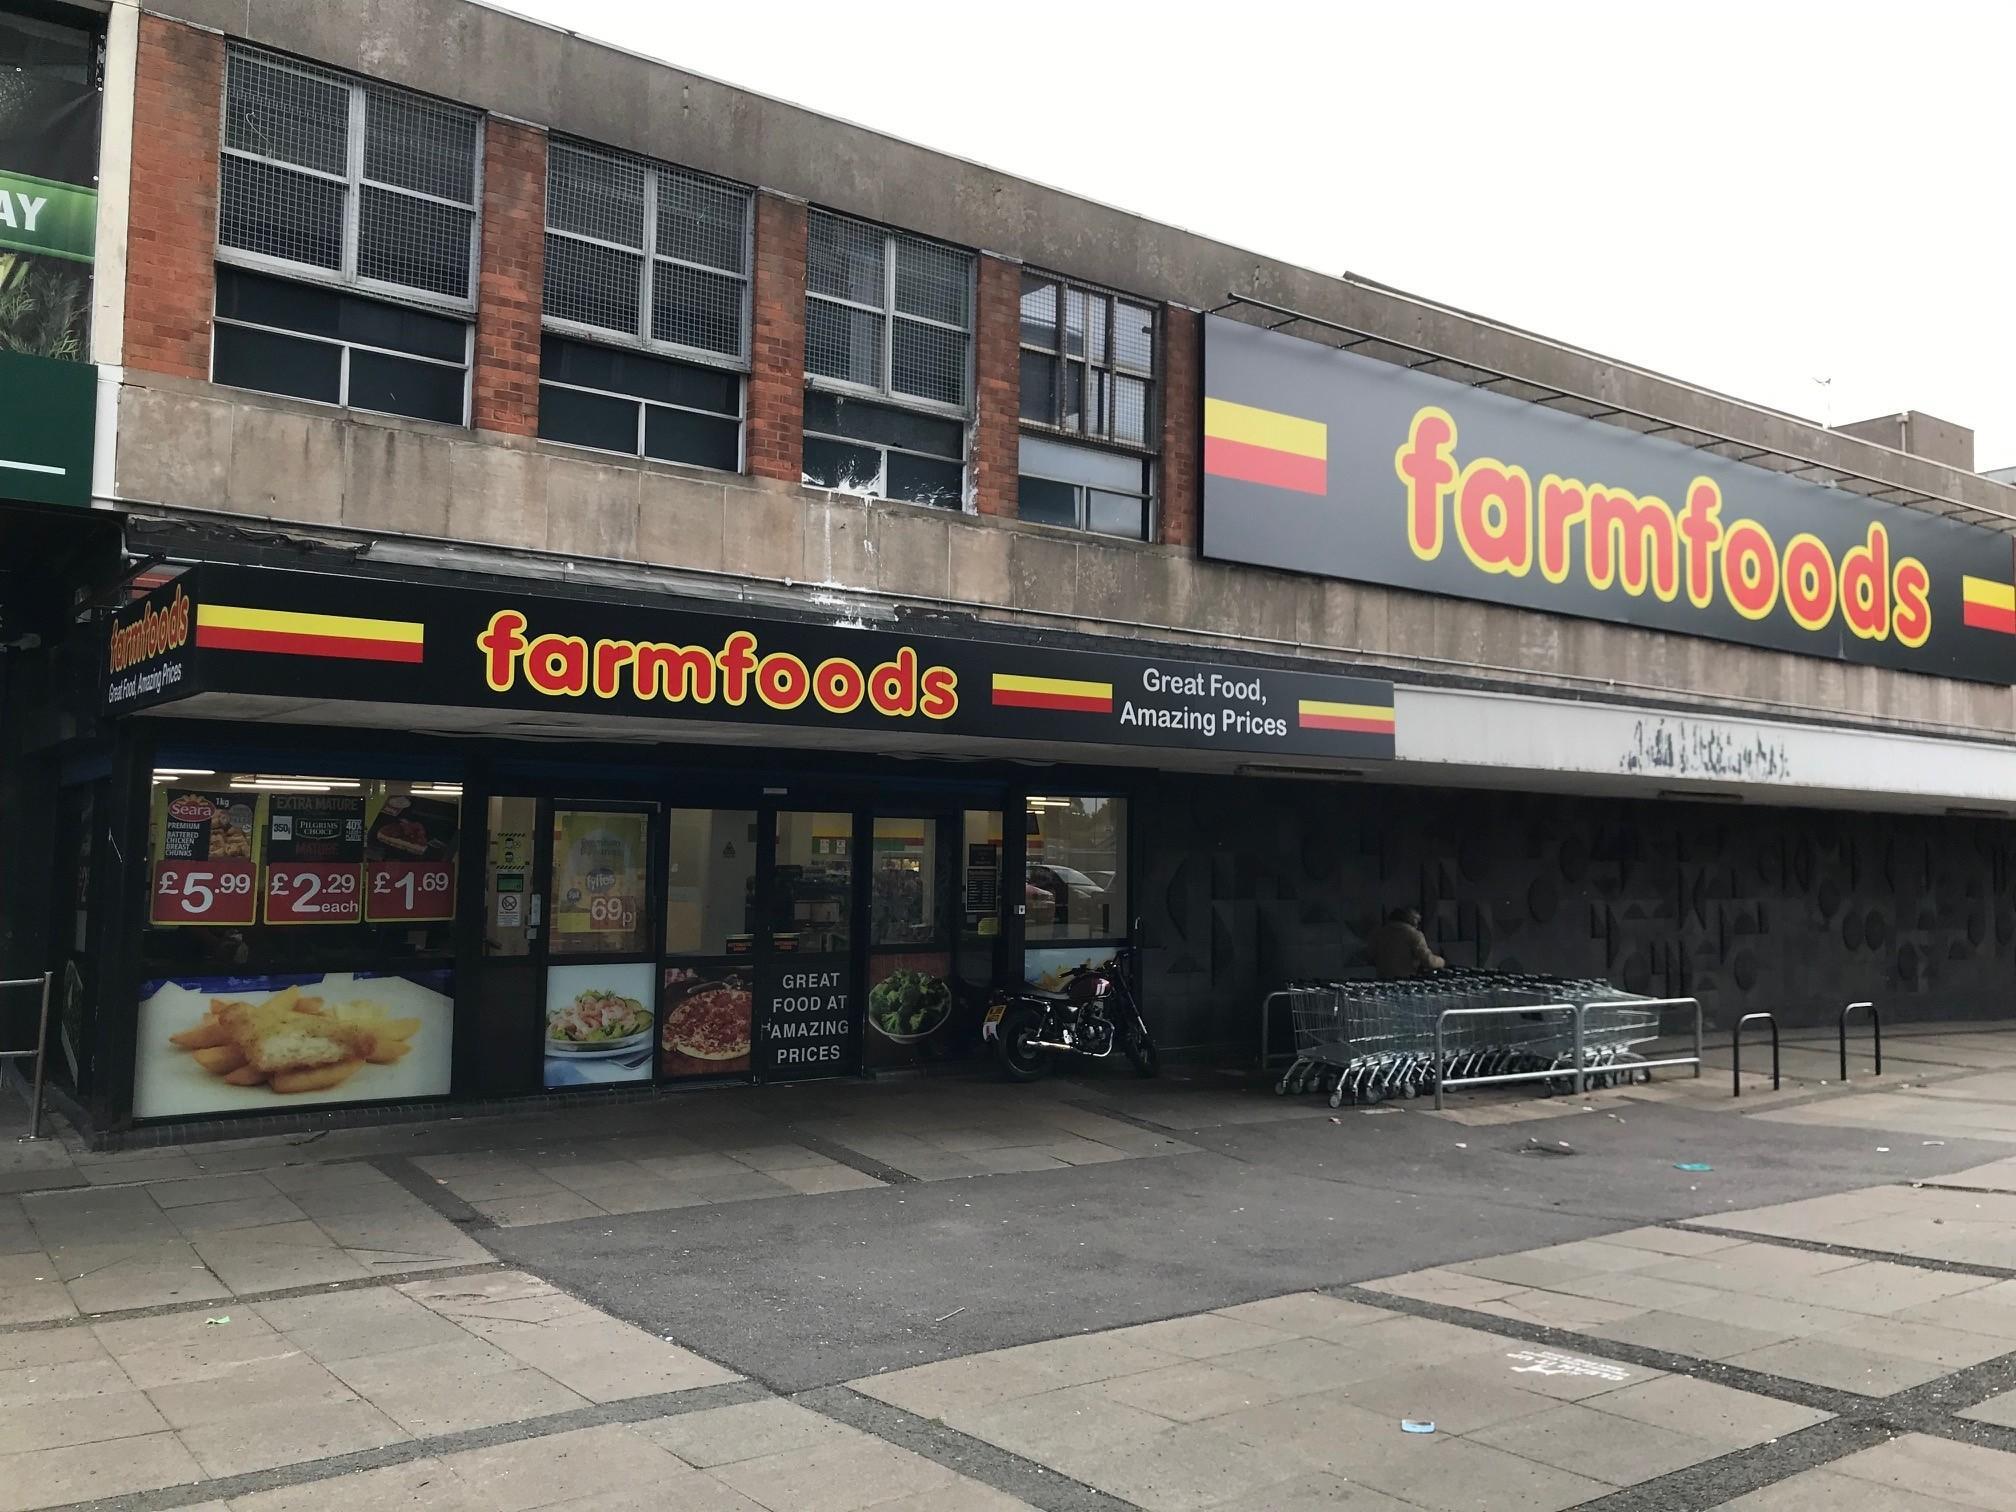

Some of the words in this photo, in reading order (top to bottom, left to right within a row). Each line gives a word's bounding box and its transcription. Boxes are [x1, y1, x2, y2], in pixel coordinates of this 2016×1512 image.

[1395, 406, 1932, 649] farmfoods
[110, 583, 189, 674] farmfoods
[476, 609, 959, 720] farmfoods
[109, 680, 124, 703] Great
[138, 667, 162, 694] Amazing
[162, 661, 183, 687] Prices
[1143, 667, 1206, 697] Great
[1210, 674, 1267, 706] Food,
[1120, 701, 1216, 737] Amazing
[1222, 709, 1288, 737] Prices
[171, 803, 212, 816] Seara
[216, 797, 230, 808] 1kg
[276, 797, 313, 810] EXTRA
[316, 798, 358, 810] MATURE
[167, 822, 200, 830] PREMIUM
[167, 831, 199, 839] BATTERED
[159, 871, 251, 914] £5.99
[270, 873, 356, 913] £2.29
[373, 871, 449, 911] £1.69
[321, 900, 359, 913] each
[591, 898, 632, 928] 69p
[782, 972, 841, 989] GREAT
[773, 996, 821, 1013] FOOD
[827, 995, 848, 1010] AT
[770, 1020, 849, 1039] AMAZING
[777, 1045, 840, 1064] PRICES
